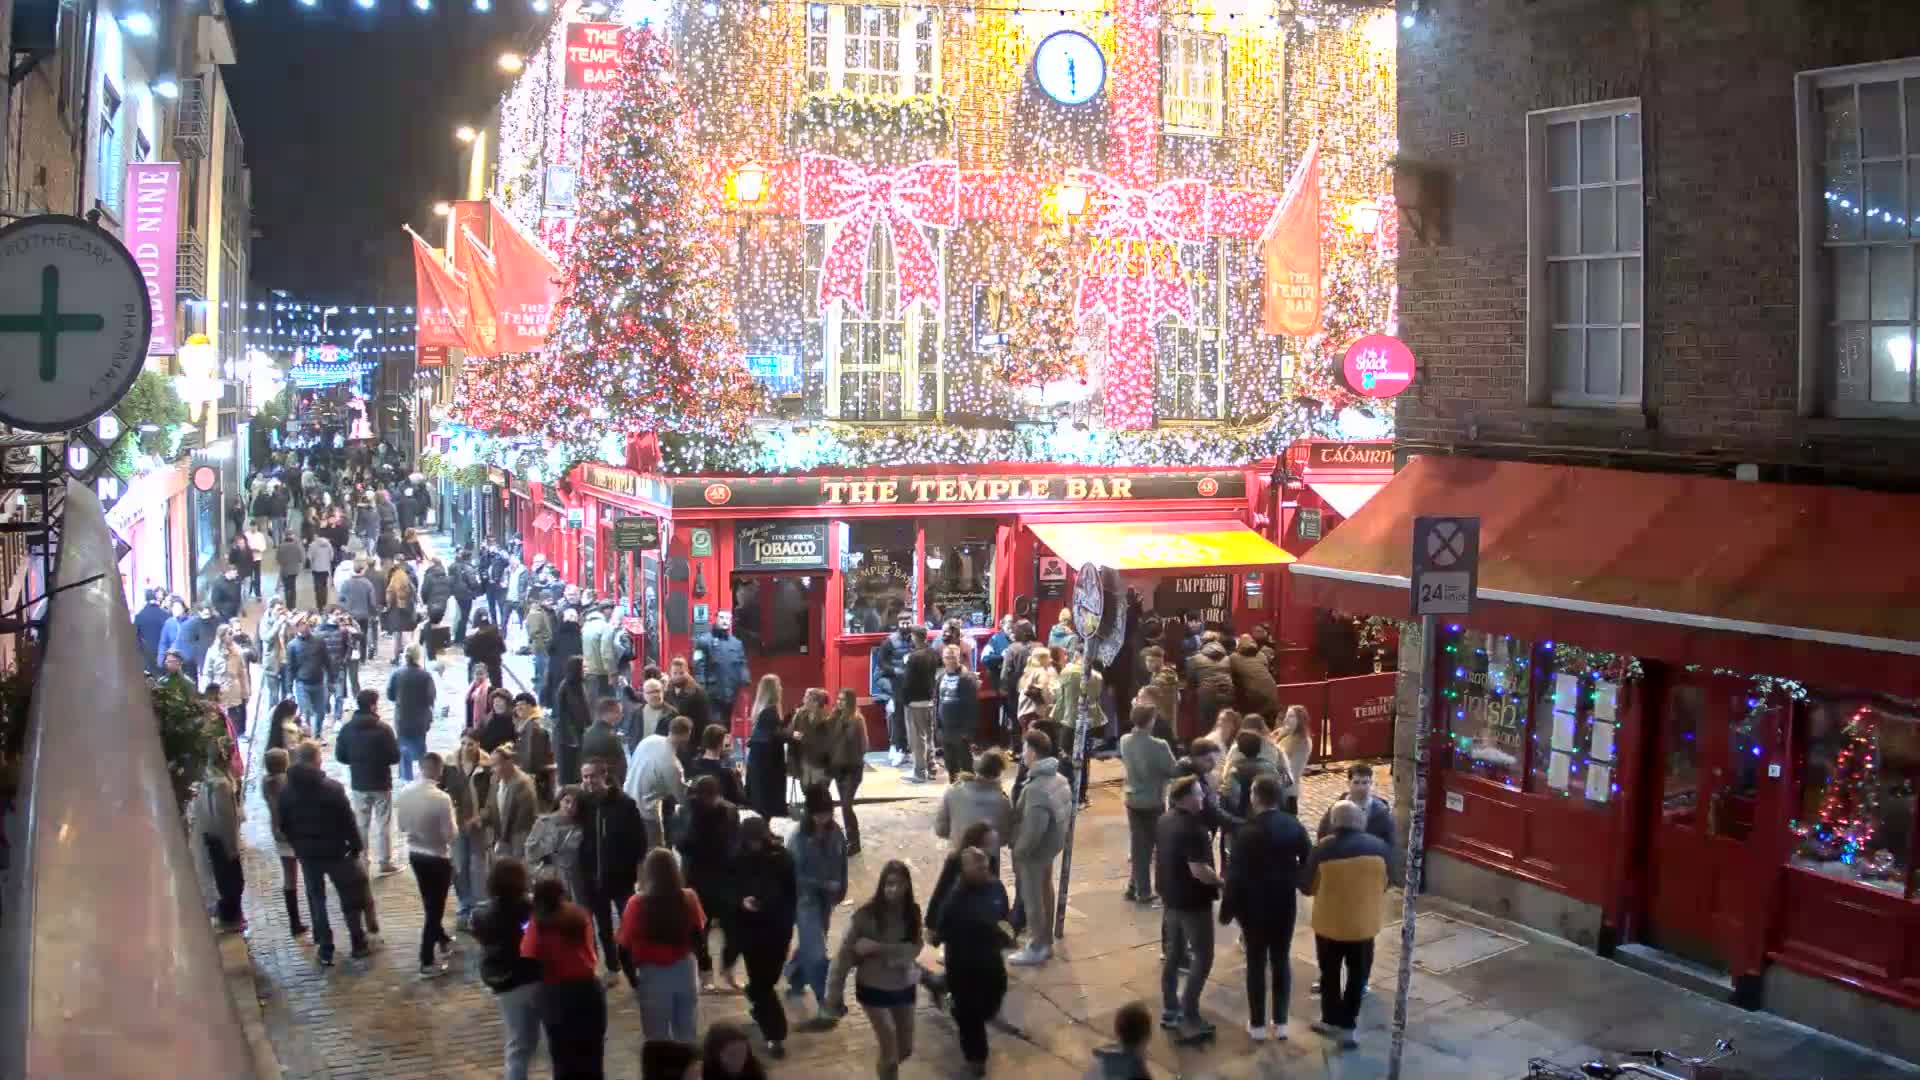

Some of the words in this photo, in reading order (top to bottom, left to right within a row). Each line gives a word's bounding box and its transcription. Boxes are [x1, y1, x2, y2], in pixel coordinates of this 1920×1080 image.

[583, 28, 617, 45] THE
[567, 47, 622, 63] TEMPL
[136, 171, 169, 232] NINE
[520, 303, 544, 313] THE
[823, 481, 899, 503] THE
[912, 479, 1050, 502] TEMPLE
[1066, 477, 1133, 499] BAR
[749, 538, 816, 562] TOBACCO
[1175, 578, 1227, 593] EMPEROR
[1423, 583, 1443, 602] 24
[1211, 593, 1225, 607] OF
